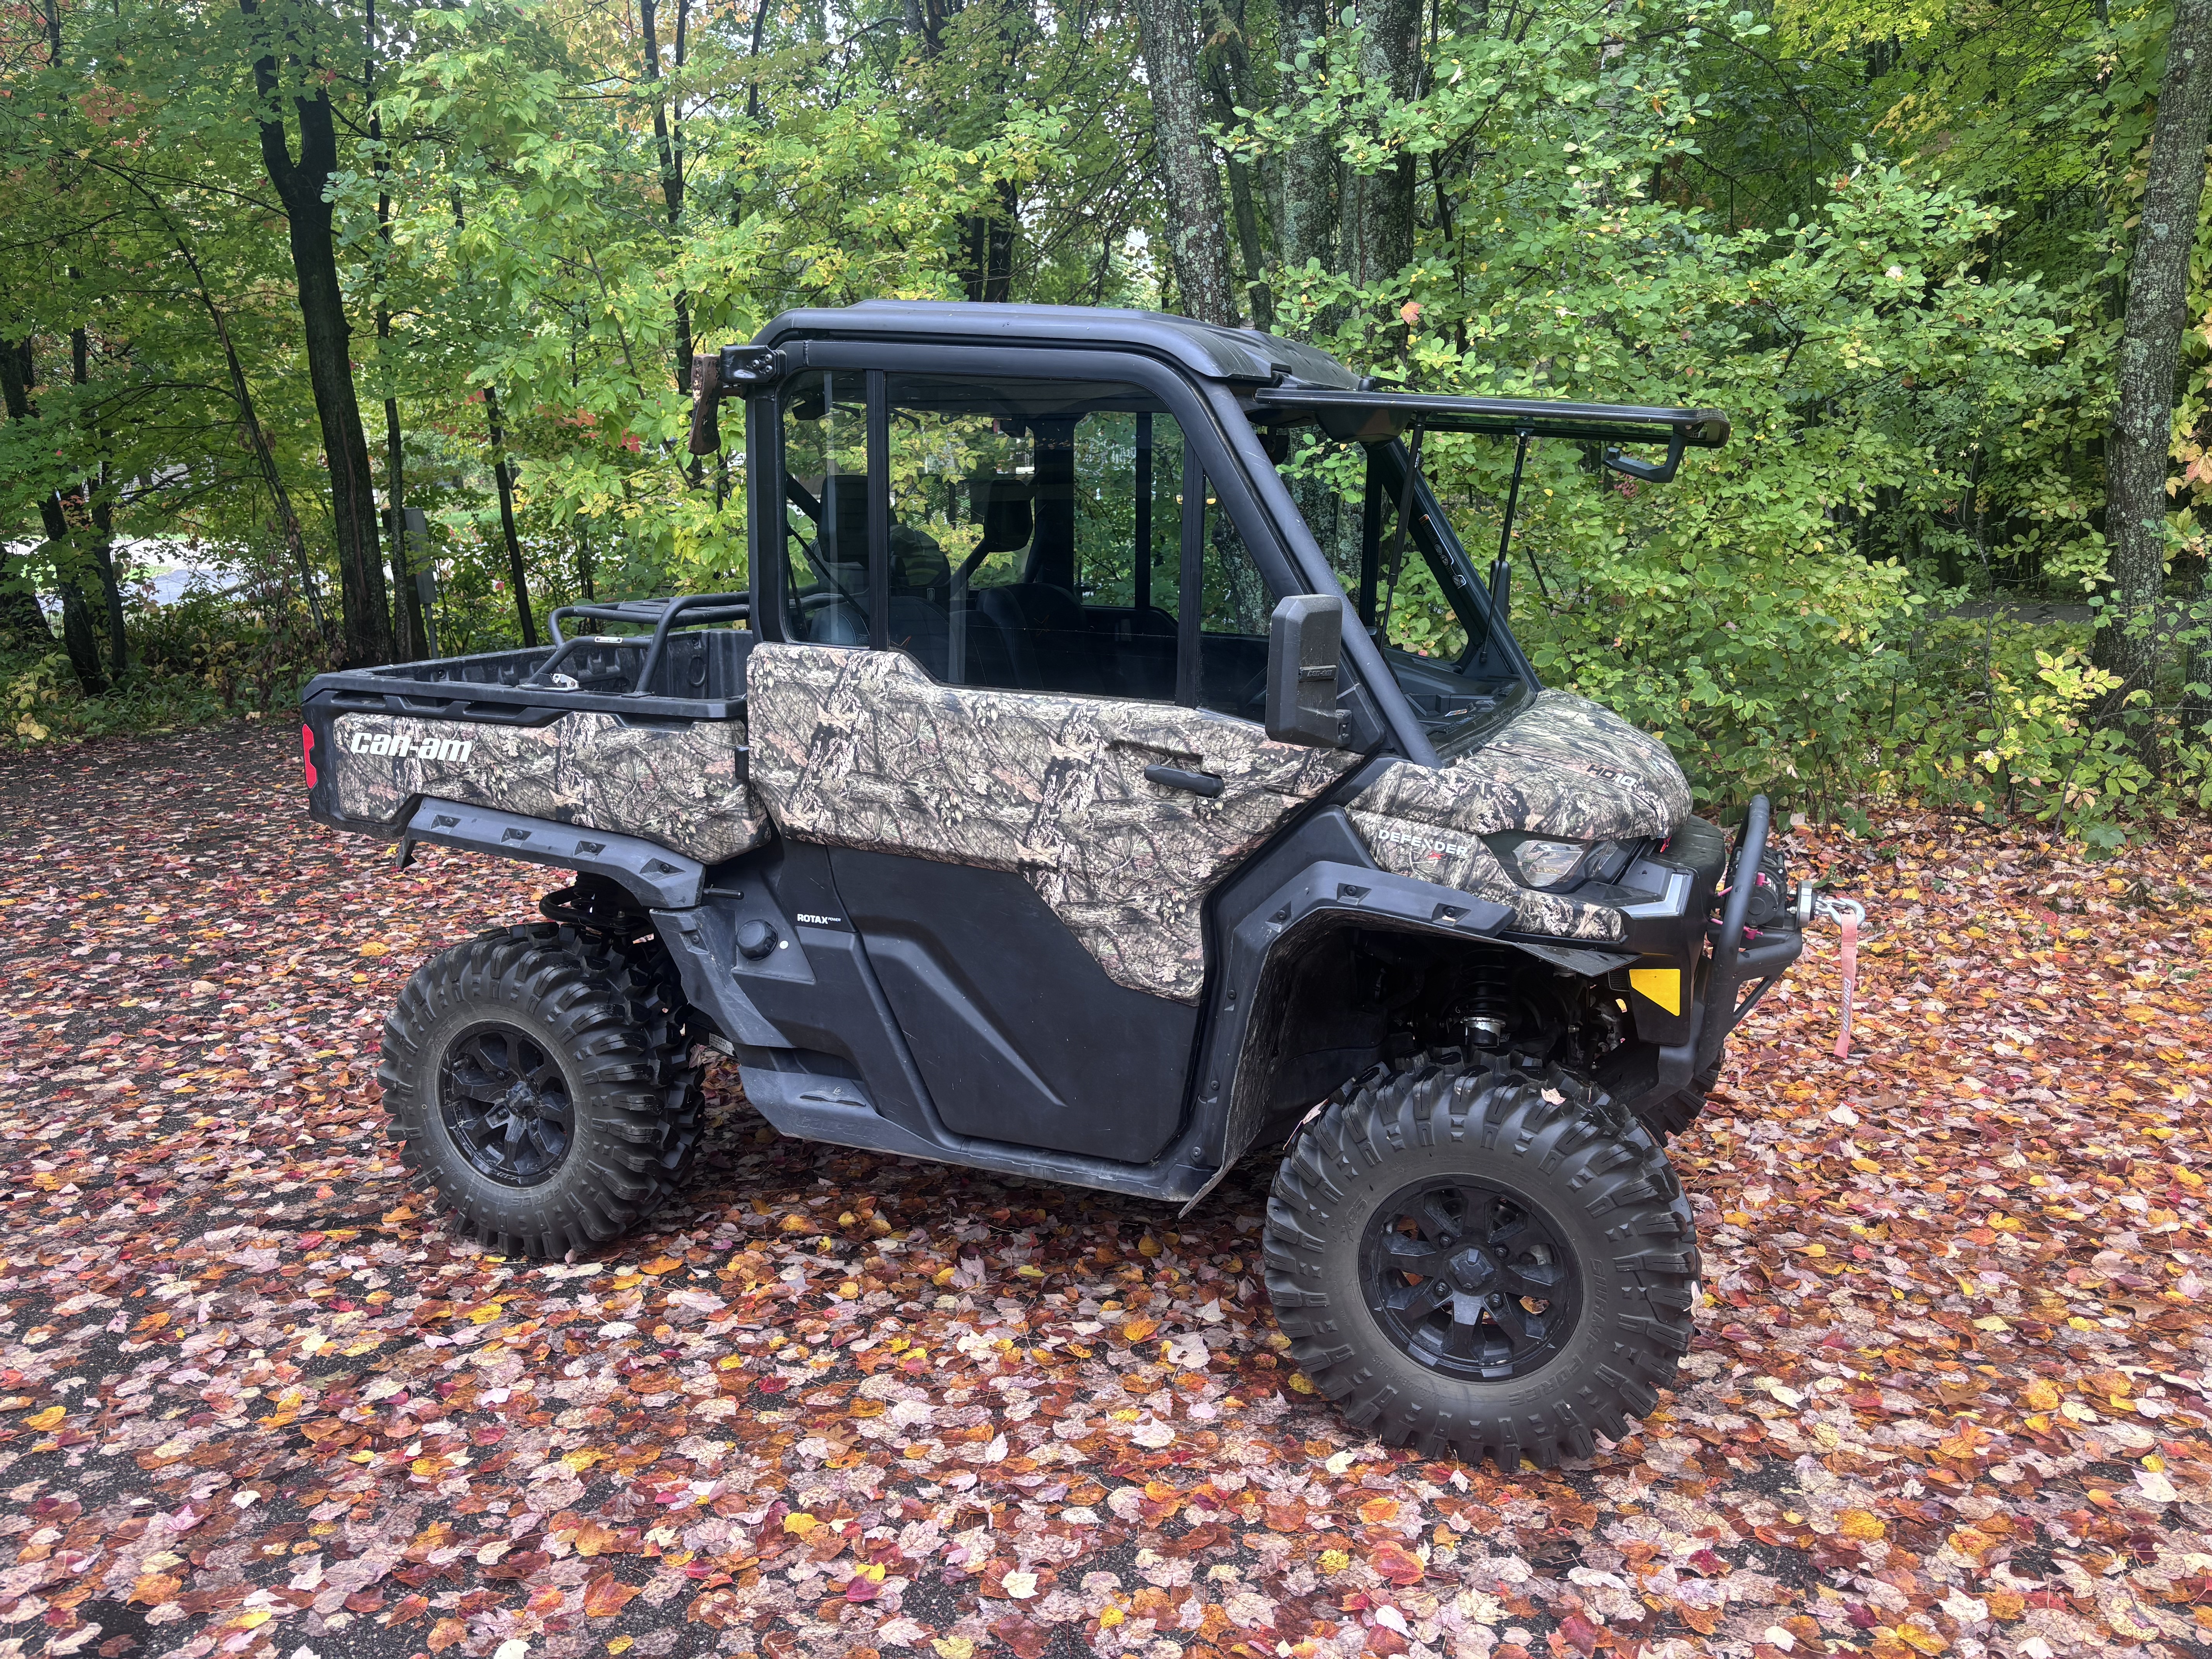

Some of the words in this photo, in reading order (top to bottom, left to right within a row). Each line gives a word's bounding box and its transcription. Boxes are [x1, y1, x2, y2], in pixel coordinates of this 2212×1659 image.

[350, 732, 472, 763] can-am
[1587, 764, 1637, 787] HD10
[1378, 829, 1468, 857] DEFENDER
[797, 913, 828, 924] ROTAX
[1843, 977, 1851, 1032] can-am
[510, 1183, 562, 1208] FORCE
[1508, 1354, 1584, 1407] FORCE
